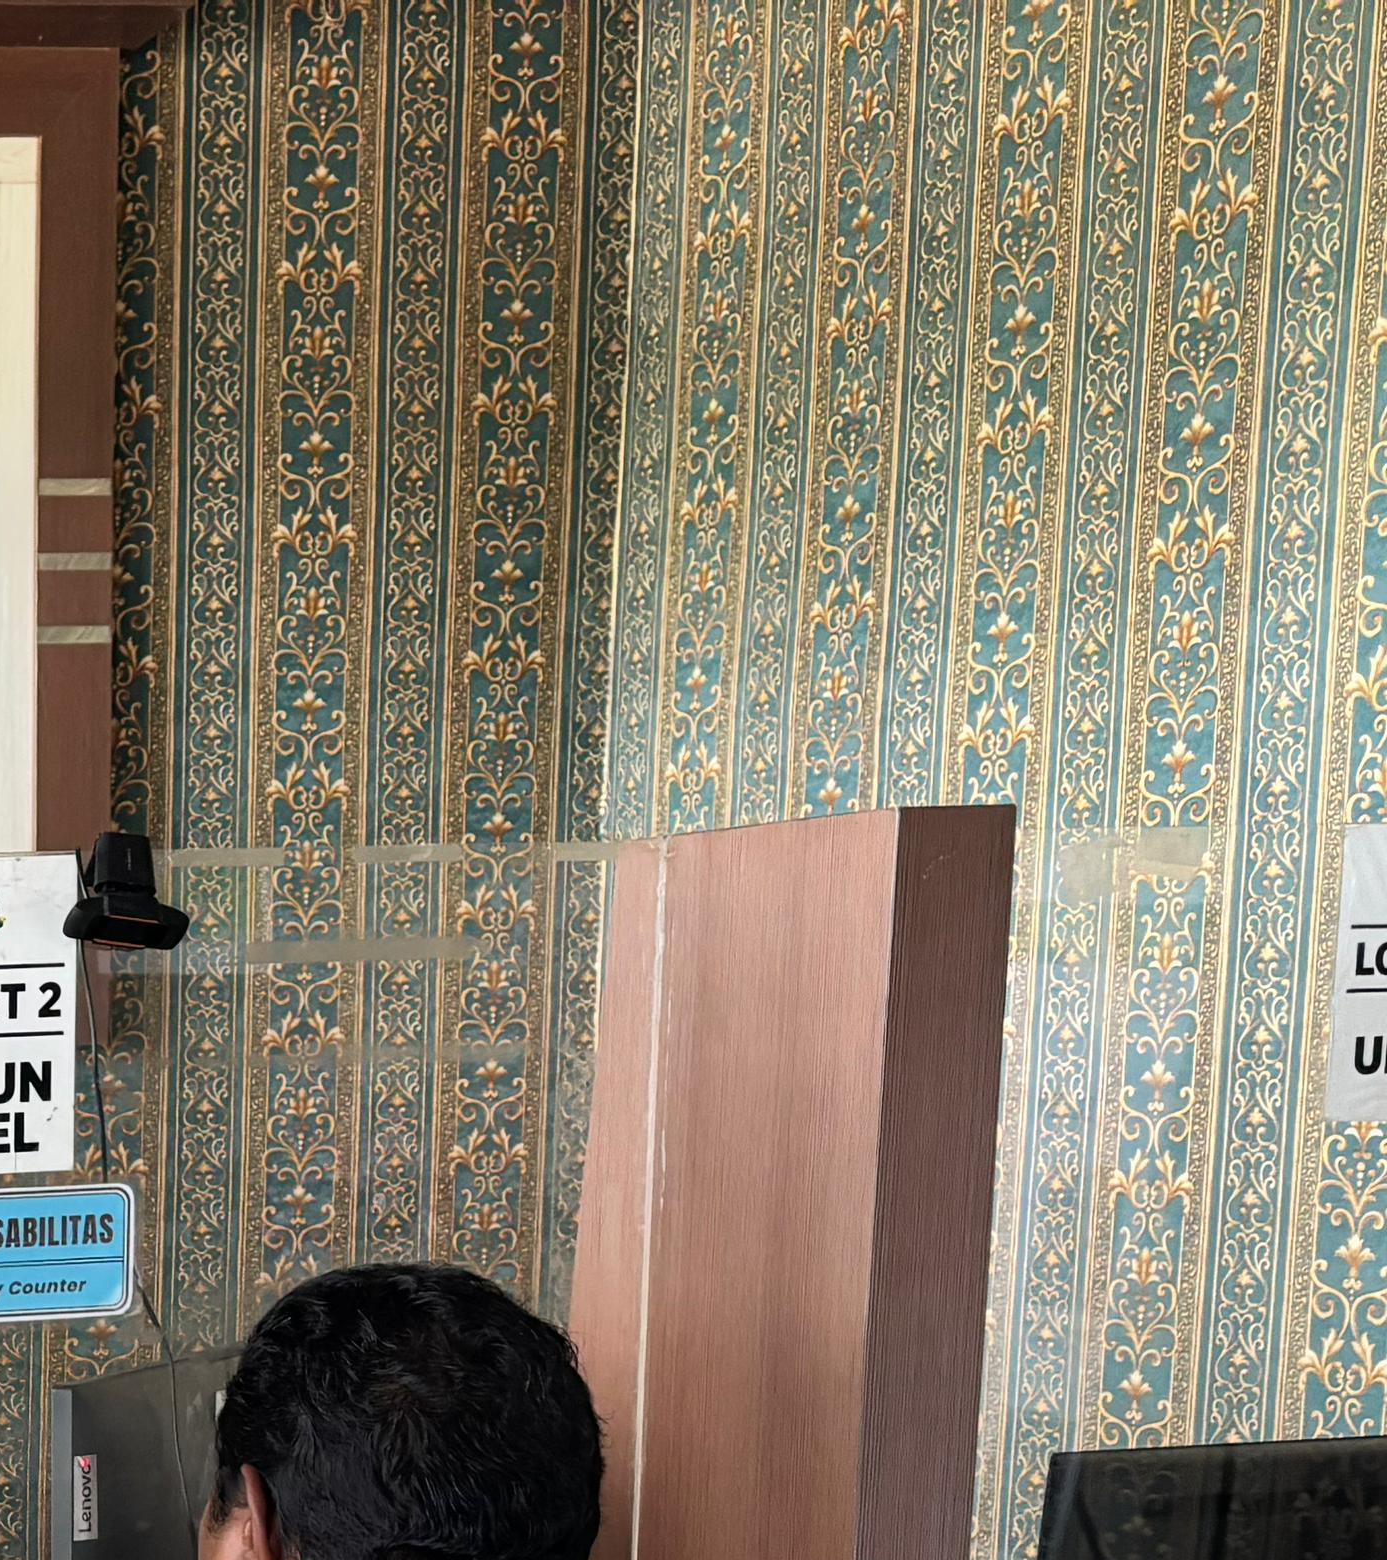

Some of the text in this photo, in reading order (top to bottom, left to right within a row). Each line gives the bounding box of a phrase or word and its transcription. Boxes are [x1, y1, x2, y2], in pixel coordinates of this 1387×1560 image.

[38, 981, 63, 1018] 2
[8, 1277, 87, 1296] Counter
[78, 1464, 92, 1533] Lenovo
